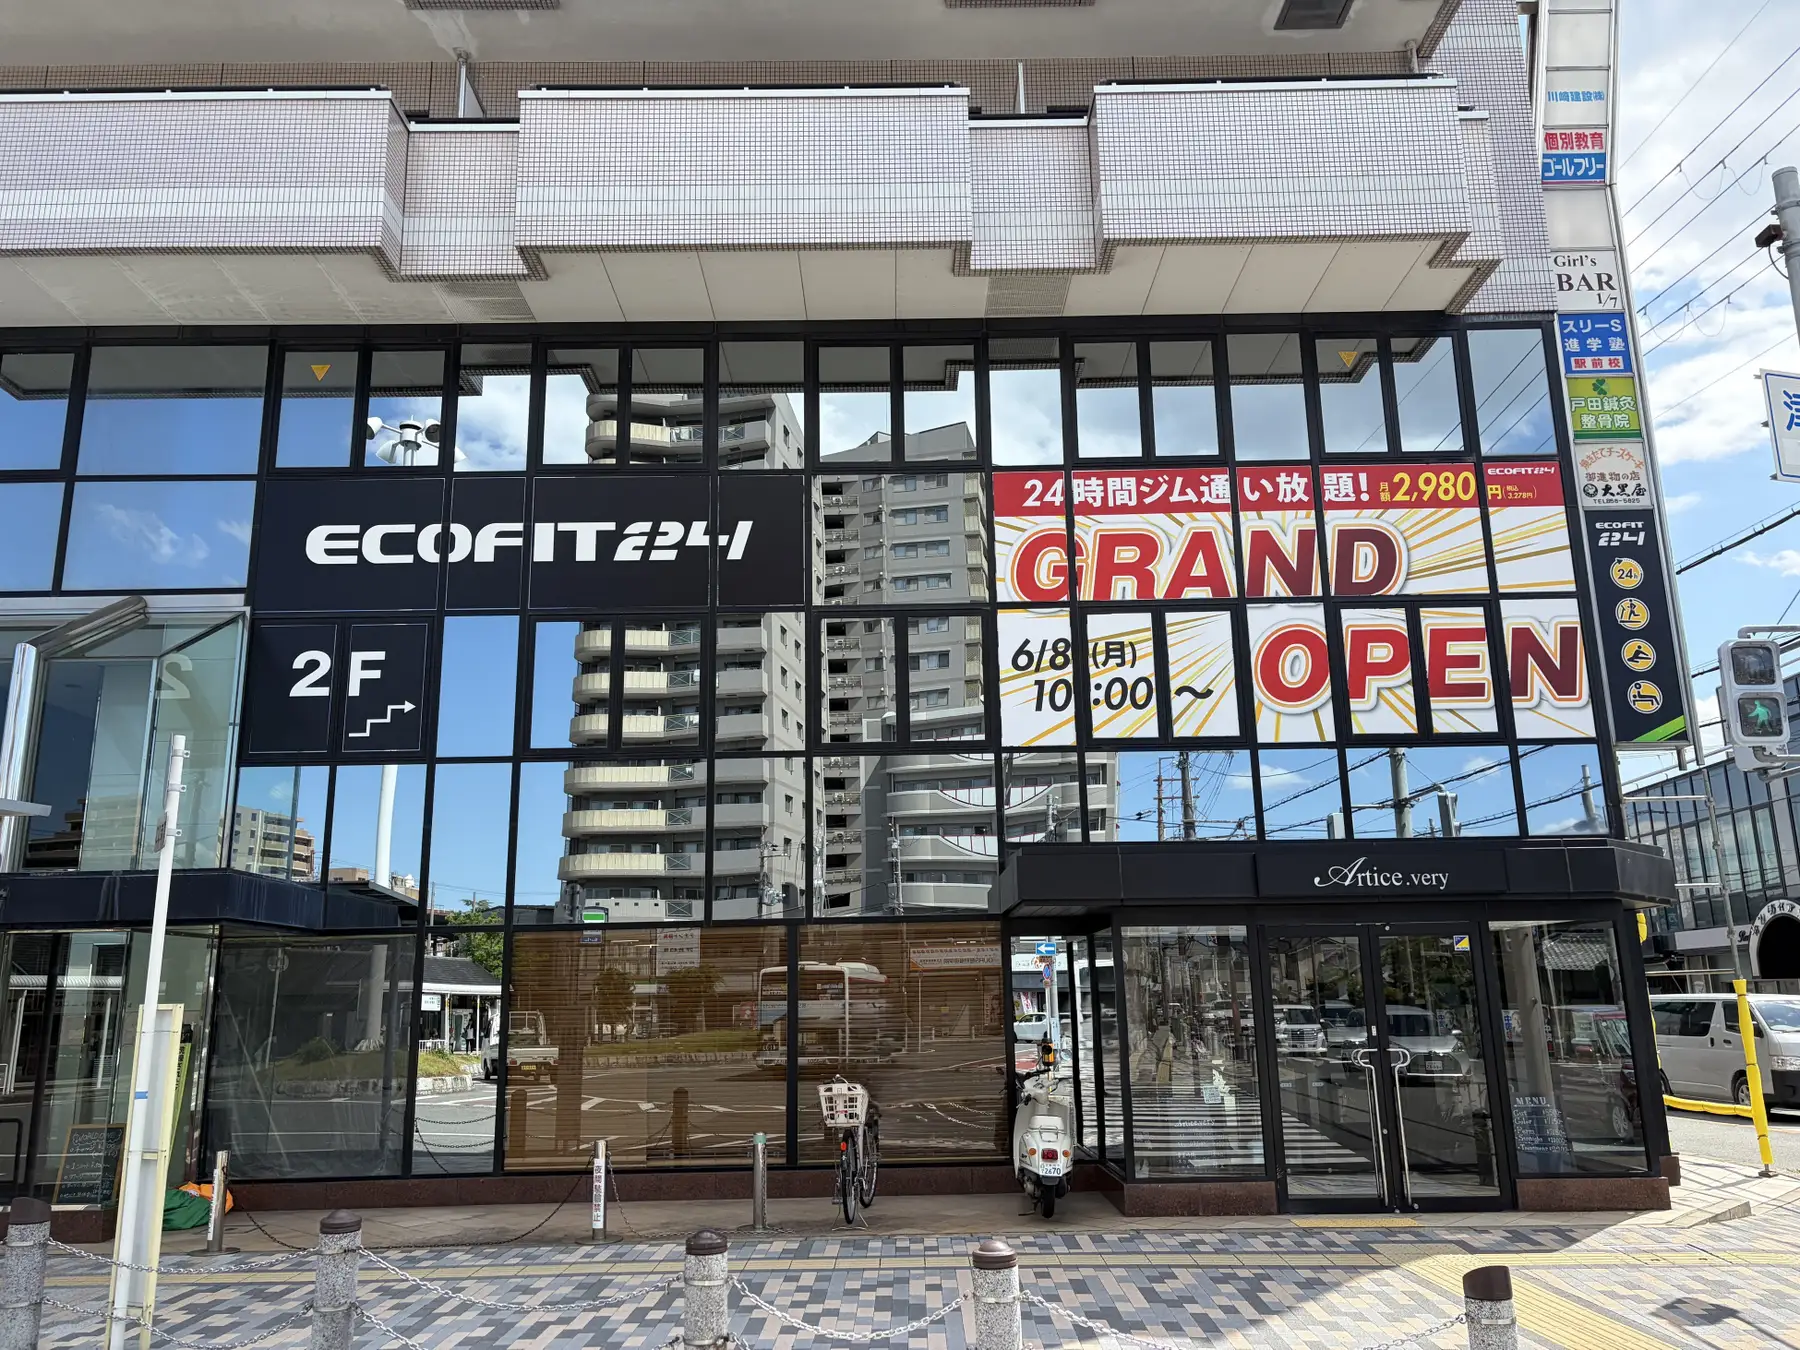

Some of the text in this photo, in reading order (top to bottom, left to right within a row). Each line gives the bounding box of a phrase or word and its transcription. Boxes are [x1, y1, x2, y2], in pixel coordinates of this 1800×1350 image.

[1544, 132, 1604, 150] 個別教育
[1544, 157, 1604, 177] ゴールフリー
[1556, 272, 1617, 292] BAR
[1597, 293, 1617, 308] 1/7
[1562, 319, 1622, 333] スリーS
[1564, 337, 1626, 352] 進学塾
[1574, 357, 1621, 369] 駅前校
[1570, 396, 1636, 412] 戸田鍼灸
[1580, 414, 1631, 429] 整骨院
[1487, 467, 1555, 476] ECOFIT24
[1601, 483, 1647, 498] 大黒屋
[1595, 521, 1644, 530] ECOFIT
[305, 520, 754, 565] ECOFIT24
[1598, 531, 1646, 547] 24
[1011, 525, 1402, 601] GRAND
[1255, 622, 1582, 706] OPEN
[289, 650, 386, 698] 2F
[1515, 1096, 1547, 1105] MENU
